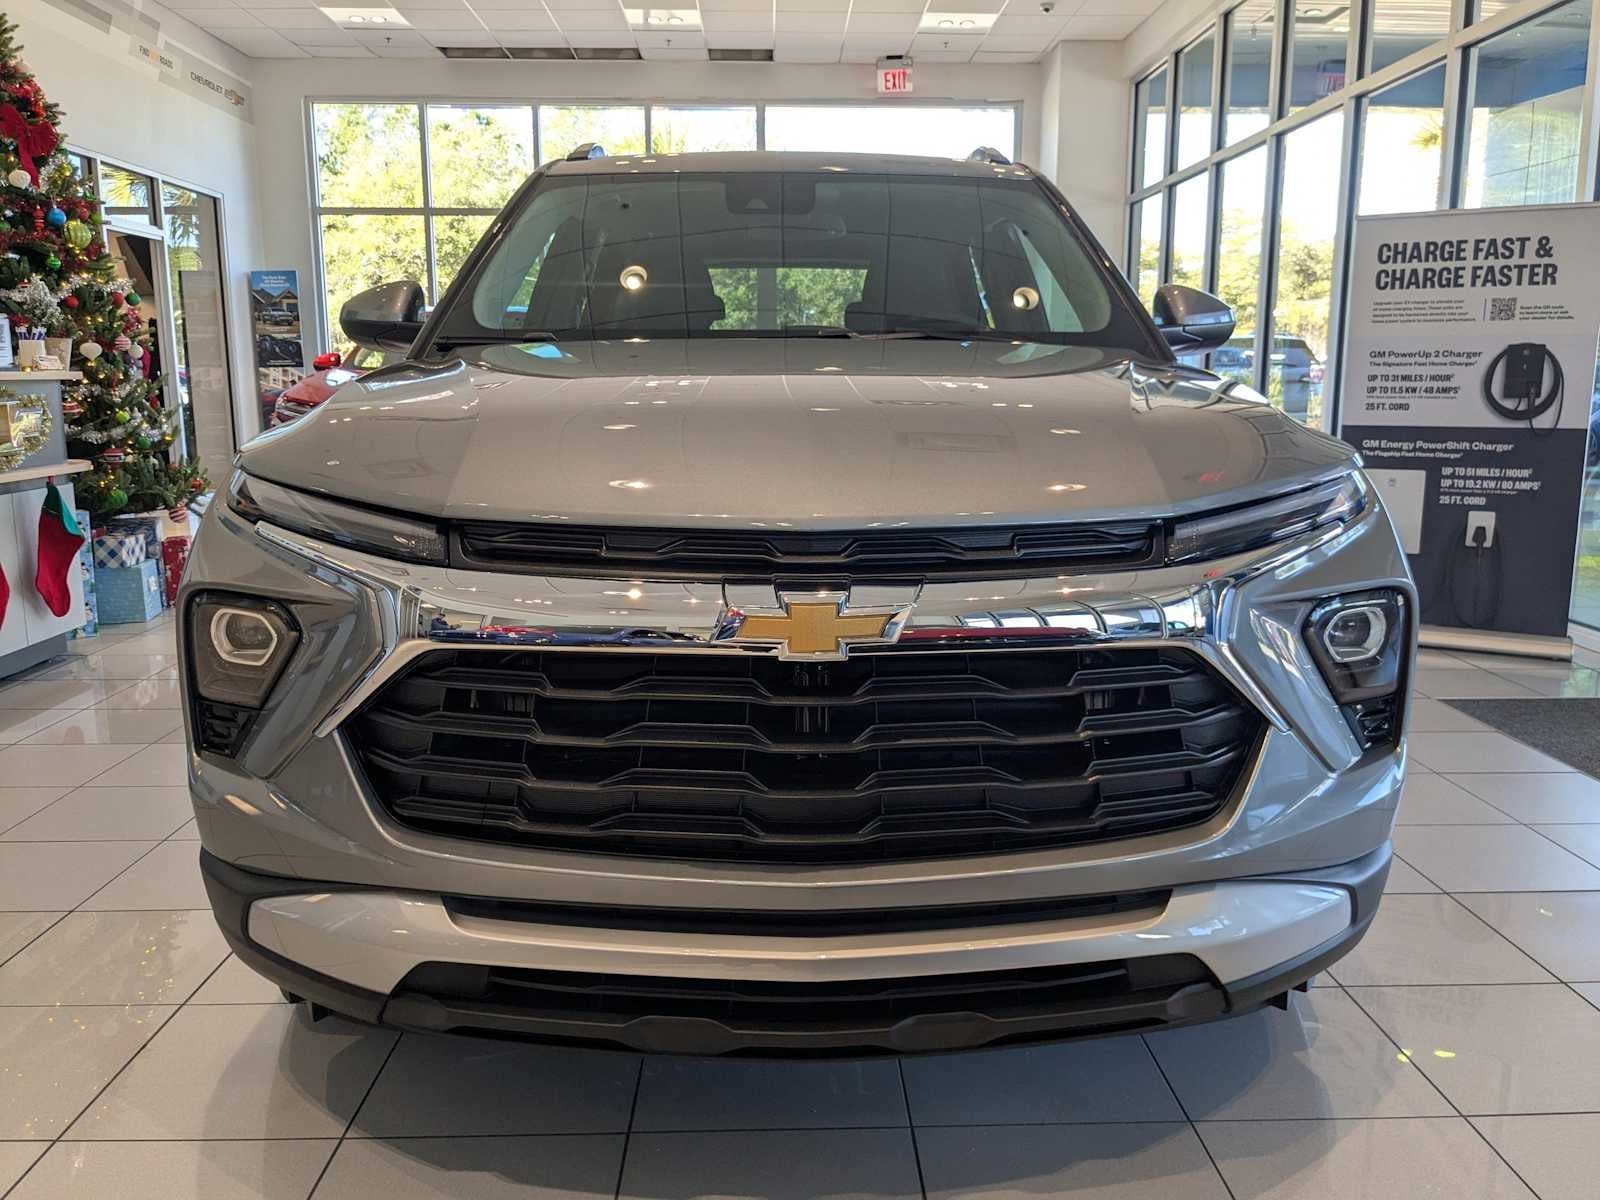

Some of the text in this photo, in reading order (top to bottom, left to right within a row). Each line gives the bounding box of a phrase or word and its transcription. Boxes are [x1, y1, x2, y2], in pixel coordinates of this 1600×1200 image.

[190, 71, 223, 95] CHEVROLET
[884, 71, 907, 90] EXIT
[1377, 235, 1554, 265] CHARGE FAST &
[1375, 263, 1558, 291] CHARGE FASTER
[1369, 349, 1483, 360] GM PowerUp 2 Charger
[1368, 374, 1378, 382] UP
[1380, 374, 1390, 382] TO
[1391, 374, 1400, 382] 31
[1400, 374, 1424, 382] MILES
[1366, 386, 1377, 394] UP
[1379, 386, 1389, 394] TO
[1405, 386, 1417, 394] KW
[1423, 386, 1434, 394] 48
[1365, 402, 1410, 411] 25 FT. CORD
[1362, 440, 1514, 452] GM Energy PowerShift Charger
[1441, 467, 1453, 476] UP
[1454, 467, 1465, 476] TO
[1475, 467, 1500, 477] MILES
[1440, 479, 1452, 488] UP
[1454, 479, 1464, 488] TO
[1482, 480, 1496, 489] KW
[1439, 495, 1450, 504] 25
[1463, 496, 1486, 505] CORD
